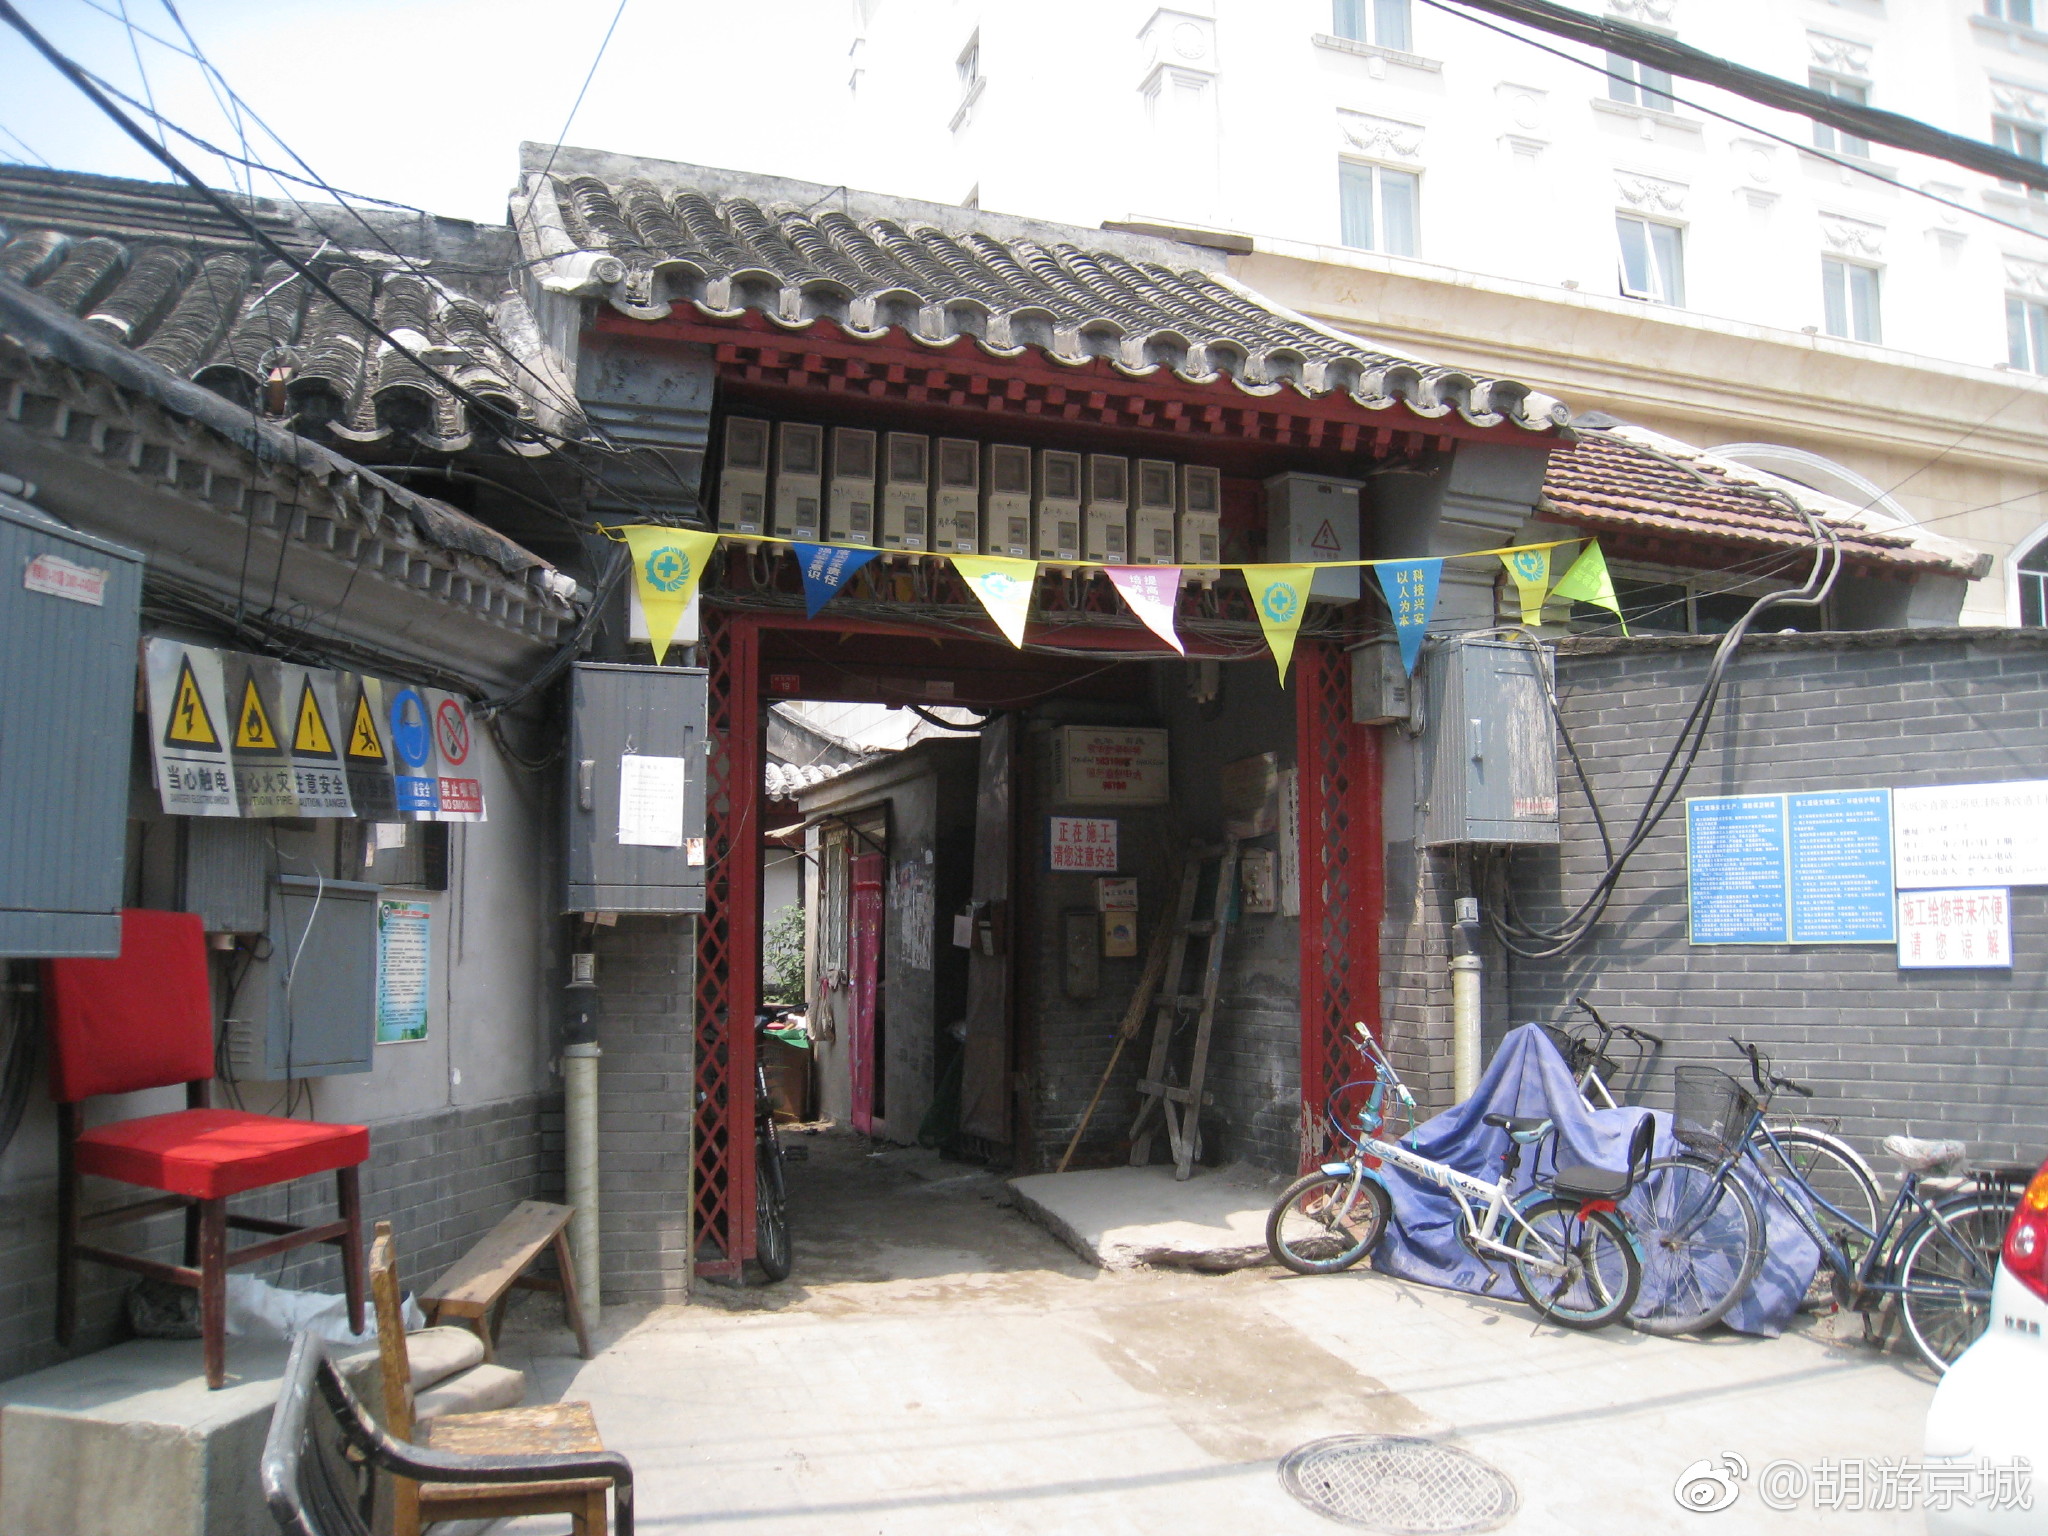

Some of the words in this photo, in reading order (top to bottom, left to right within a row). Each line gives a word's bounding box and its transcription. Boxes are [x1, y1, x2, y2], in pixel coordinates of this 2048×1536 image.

[1397, 571, 1411, 627] 以人为本
[1412, 569, 1425, 625] 科技兴安
[167, 765, 230, 793] 当心触电
[442, 799, 452, 810] NO
[1058, 821, 1111, 844] 正在施工
[1053, 845, 1116, 868] 请您注意安全
[1903, 896, 2003, 927] 施工给您带来不便
